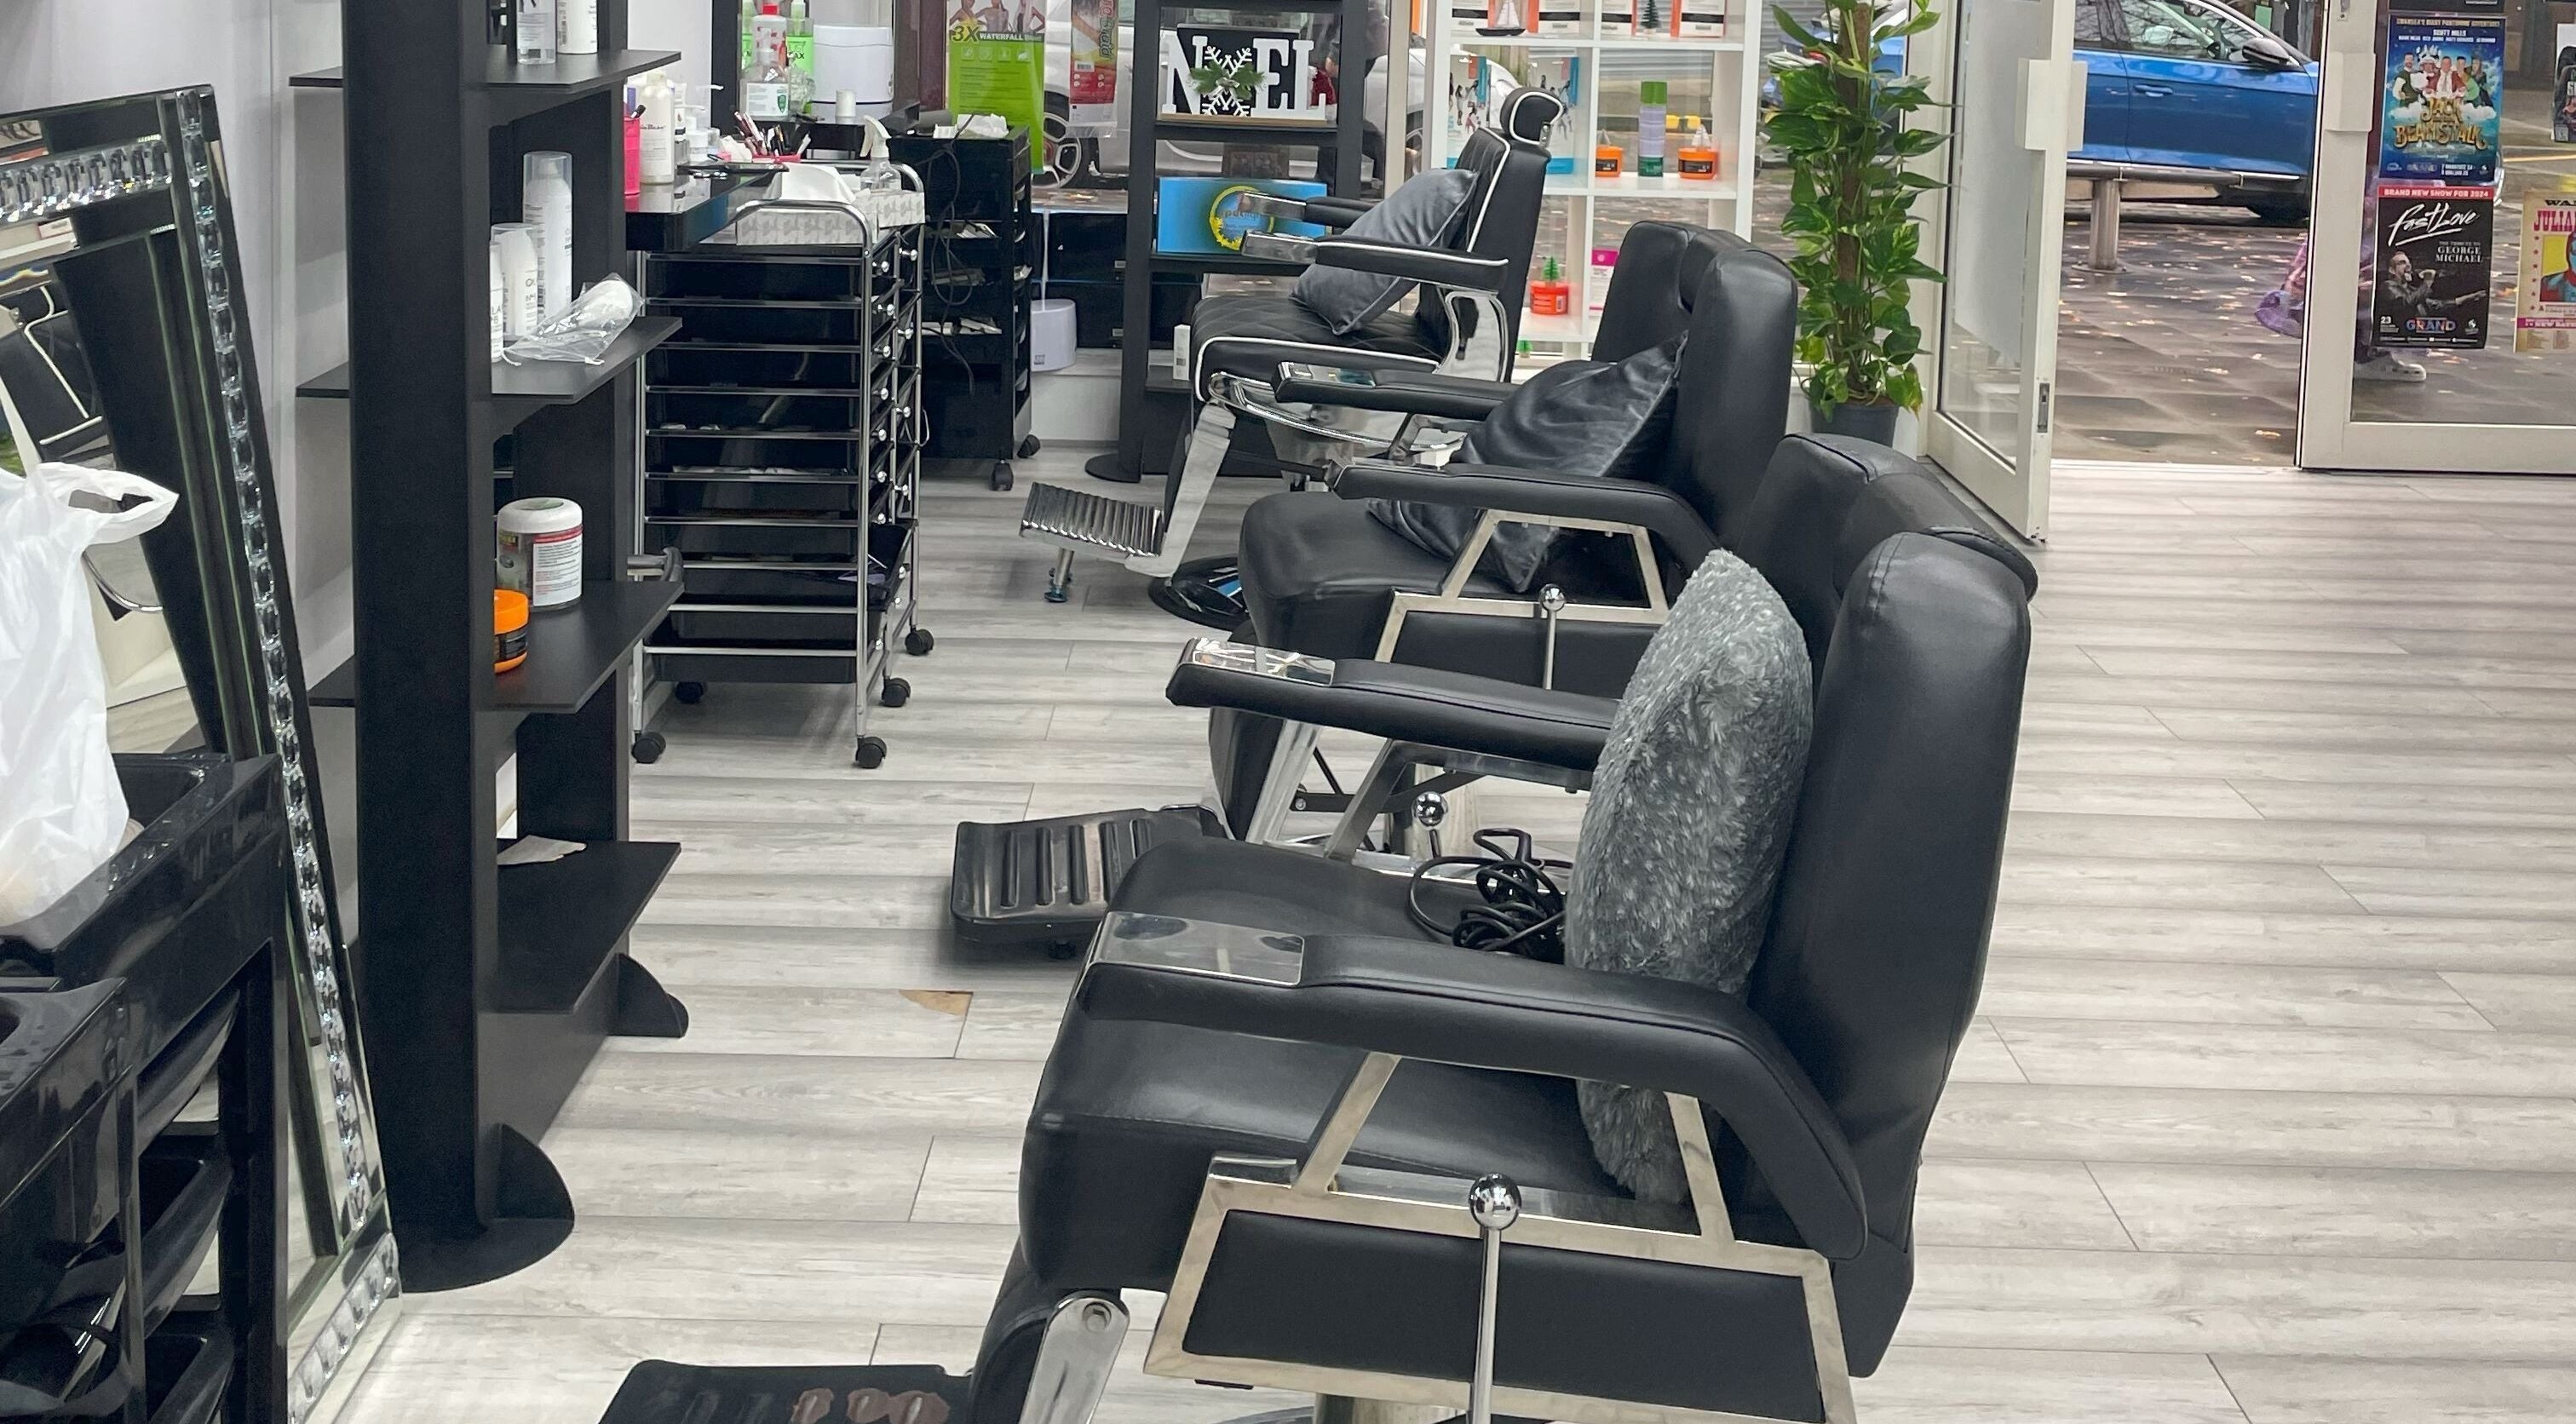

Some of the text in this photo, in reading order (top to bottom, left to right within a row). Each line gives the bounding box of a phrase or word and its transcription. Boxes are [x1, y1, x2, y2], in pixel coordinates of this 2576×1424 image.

[952, 25, 980, 42] 3X
[980, 32, 1024, 41] WATERFALL
[1159, 31, 1326, 120] NEL
[2533, 210, 2576, 232] JULIA
[2406, 318, 2457, 333] GRAND
